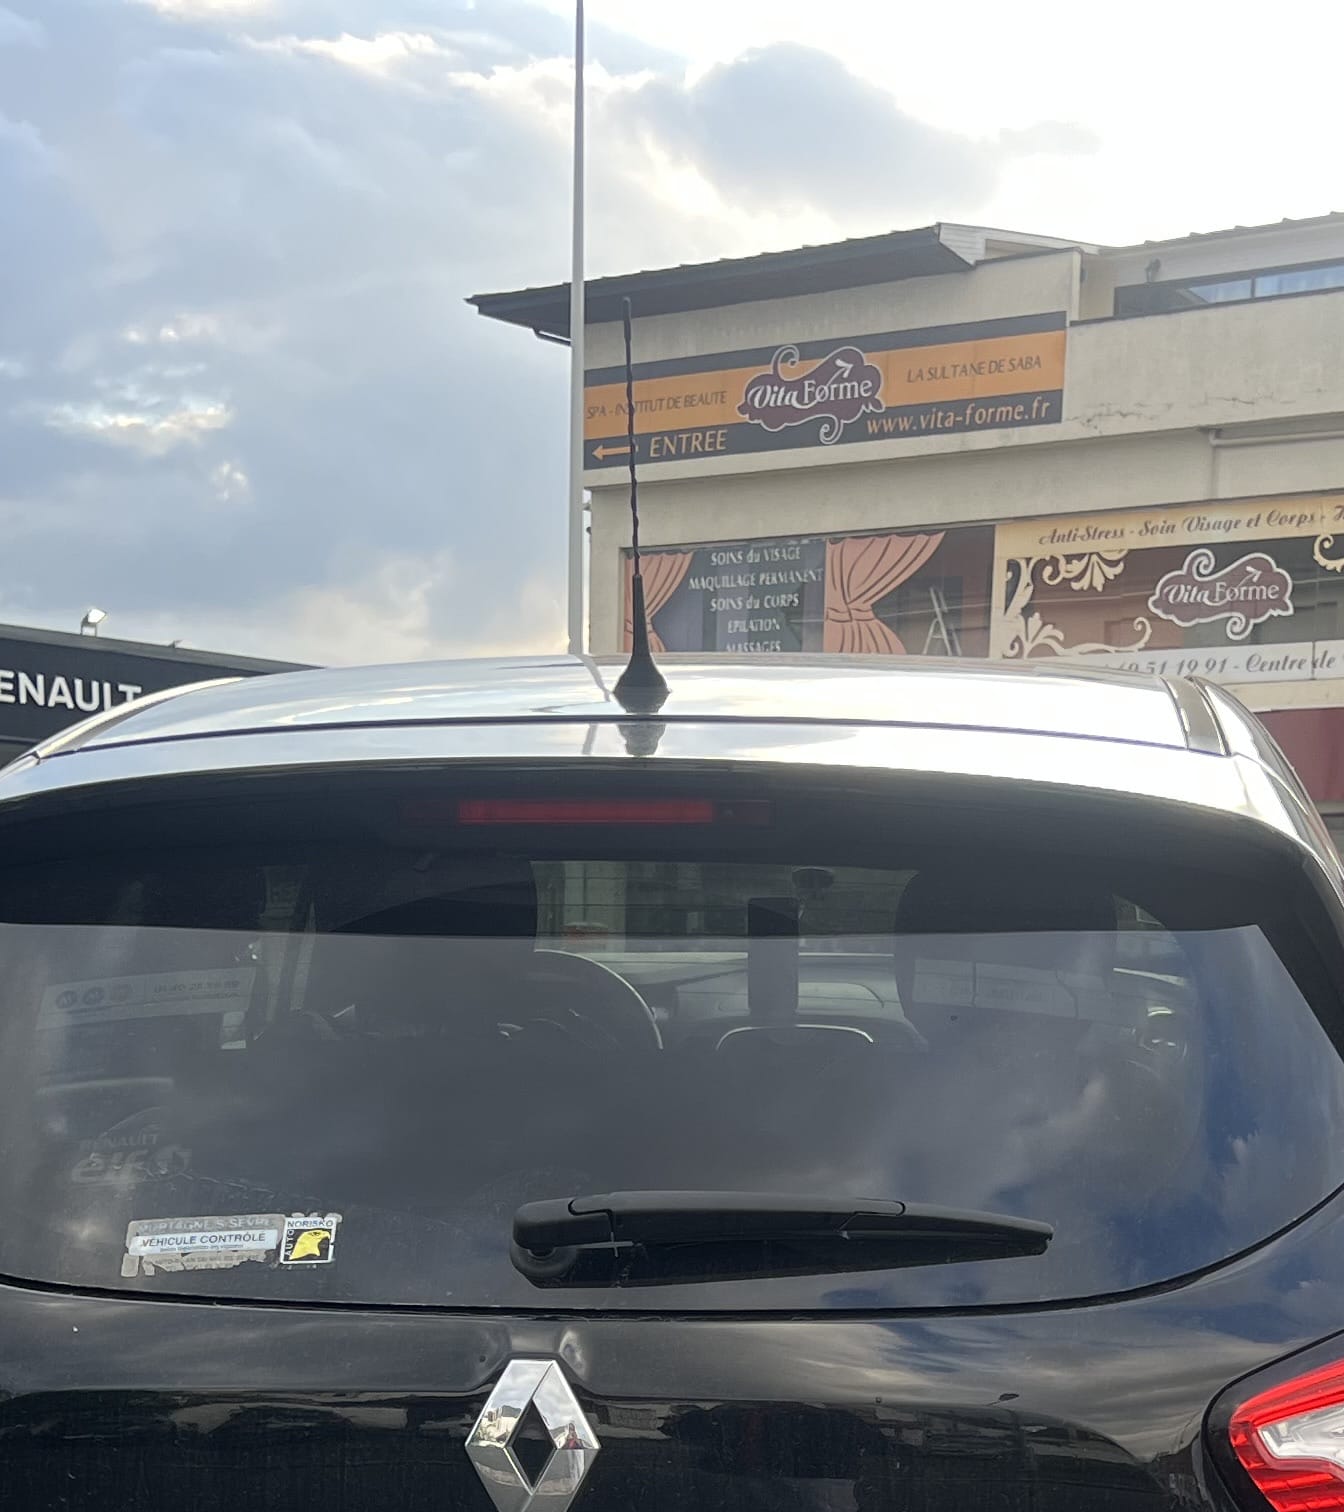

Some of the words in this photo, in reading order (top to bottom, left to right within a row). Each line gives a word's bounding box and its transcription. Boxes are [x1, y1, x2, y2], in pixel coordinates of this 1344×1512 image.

[907, 368, 924, 383] LA
[927, 360, 985, 379] SULTANE
[987, 360, 1005, 374] DE
[1009, 355, 1042, 371] SABA
[587, 405, 606, 419] SPA
[667, 397, 681, 410] DE
[683, 391, 727, 407] BEAUTE
[748, 384, 798, 408] Vita
[803, 379, 873, 405] Forme
[866, 397, 1051, 434] www.vita-forme.fr
[649, 430, 728, 457] ENTREE
[1039, 526, 1125, 547] Anti-Stress
[1139, 518, 1176, 537] Soin
[1182, 514, 1242, 537] Visage
[1246, 513, 1261, 529] et
[1265, 508, 1316, 531] Corps
[711, 551, 743, 565] SOINS
[747, 549, 760, 563] du
[763, 546, 801, 561] VISAGE
[688, 573, 756, 592] MAQUILLAGE
[759, 568, 824, 586] PERMANENT
[1164, 583, 1210, 606] Vita
[1213, 580, 1280, 602] Forme
[710, 596, 743, 612] SOINS
[746, 595, 760, 609] du
[763, 593, 800, 608] CORPS
[1246, 653, 1308, 673] Centre
[1312, 651, 1334, 670] de
[287, 1220, 334, 1228] NORISKO
[284, 1229, 295, 1256] AUTO
